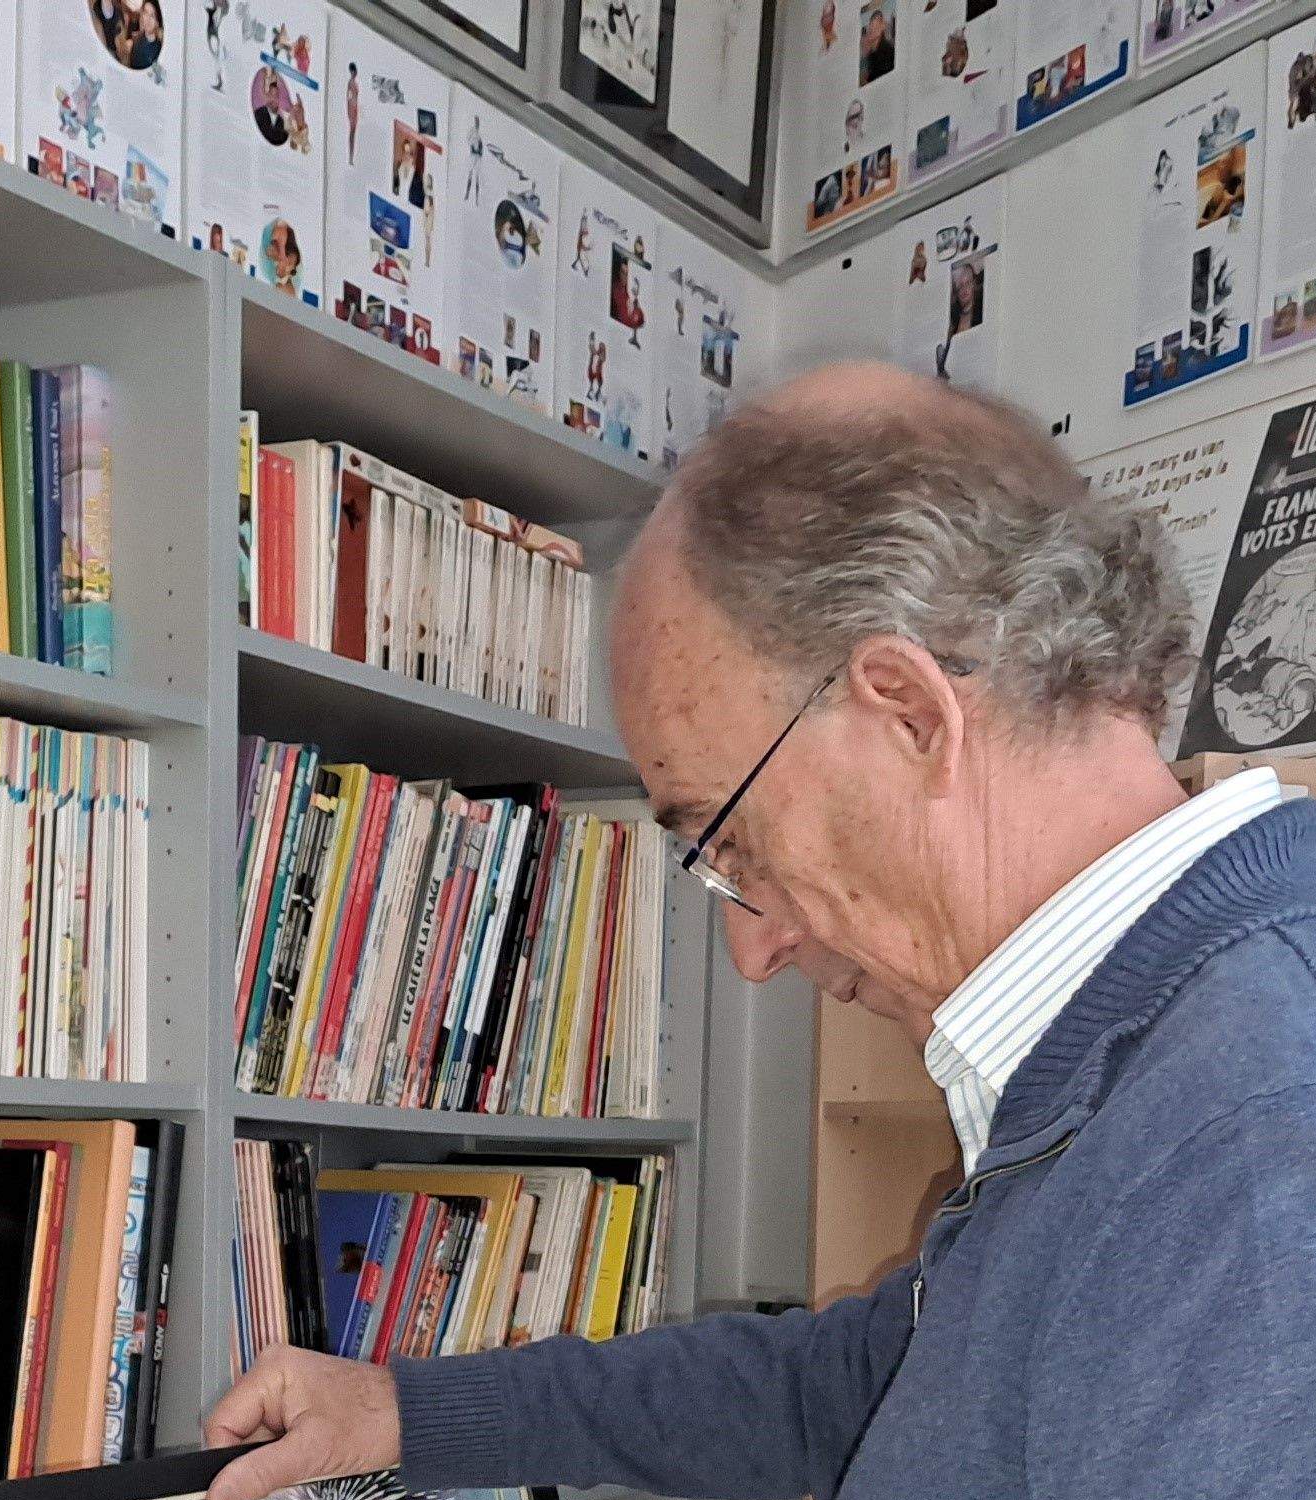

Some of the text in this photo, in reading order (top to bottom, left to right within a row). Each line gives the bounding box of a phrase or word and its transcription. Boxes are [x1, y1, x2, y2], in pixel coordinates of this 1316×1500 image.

[1239, 518, 1297, 559] VOTES
[418, 876, 444, 927] PLAGE
[415, 930, 429, 947] LA
[412, 951, 426, 965] DE
[398, 1008, 414, 1025] LE
